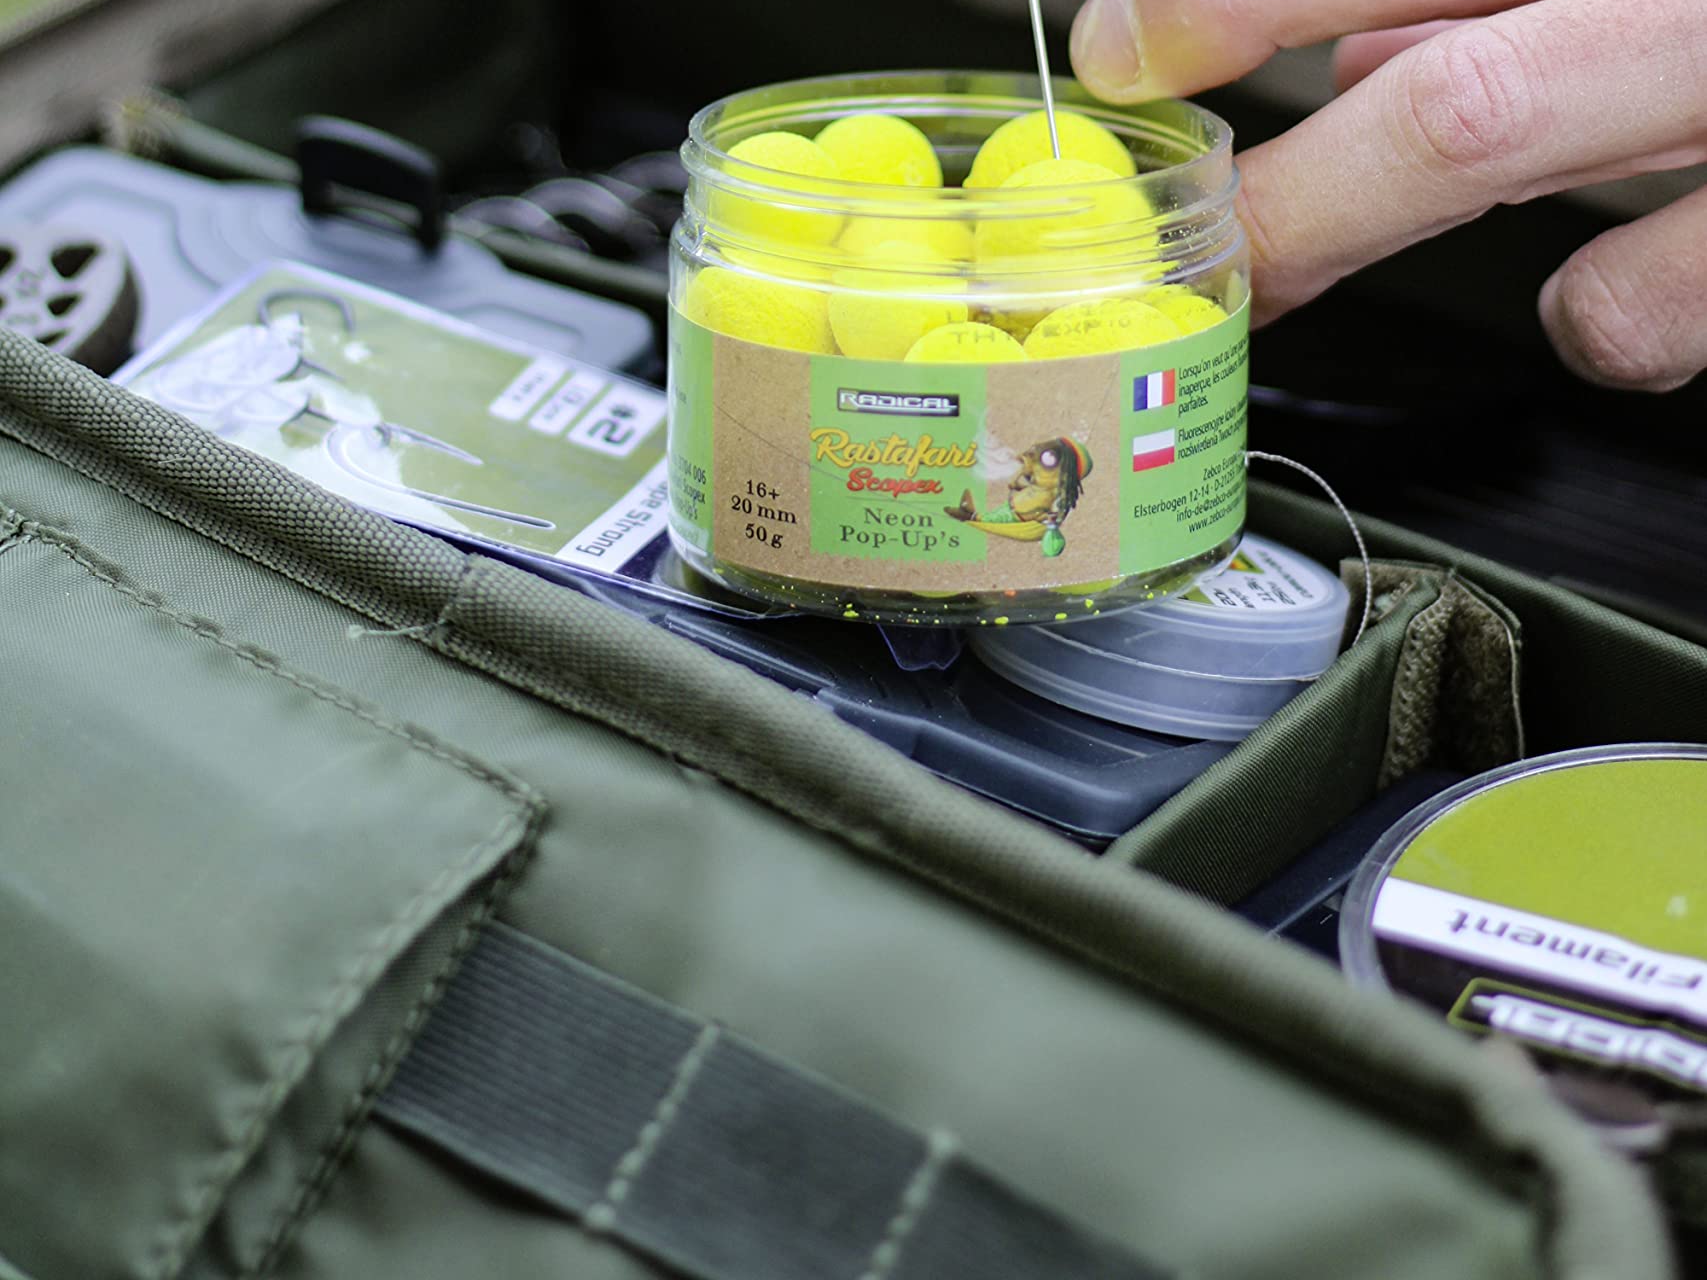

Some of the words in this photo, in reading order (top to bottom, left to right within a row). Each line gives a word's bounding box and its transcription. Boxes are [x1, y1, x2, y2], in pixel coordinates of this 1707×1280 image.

[840, 392, 958, 413] RADICAL
[809, 427, 978, 478] Rastafari
[746, 479, 780, 500] 16+
[847, 467, 944, 498] Scopex
[731, 495, 753, 514] 20
[757, 504, 797, 524] mm
[1134, 495, 1187, 519] Elsterbogen
[1189, 483, 1209, 503] 12-14
[864, 507, 934, 527] Neon
[575, 508, 652, 557] Strong
[745, 523, 768, 542] 50
[771, 532, 783, 549] g
[839, 524, 960, 551] Pop-Up's
[1448, 907, 1704, 990] Filament
